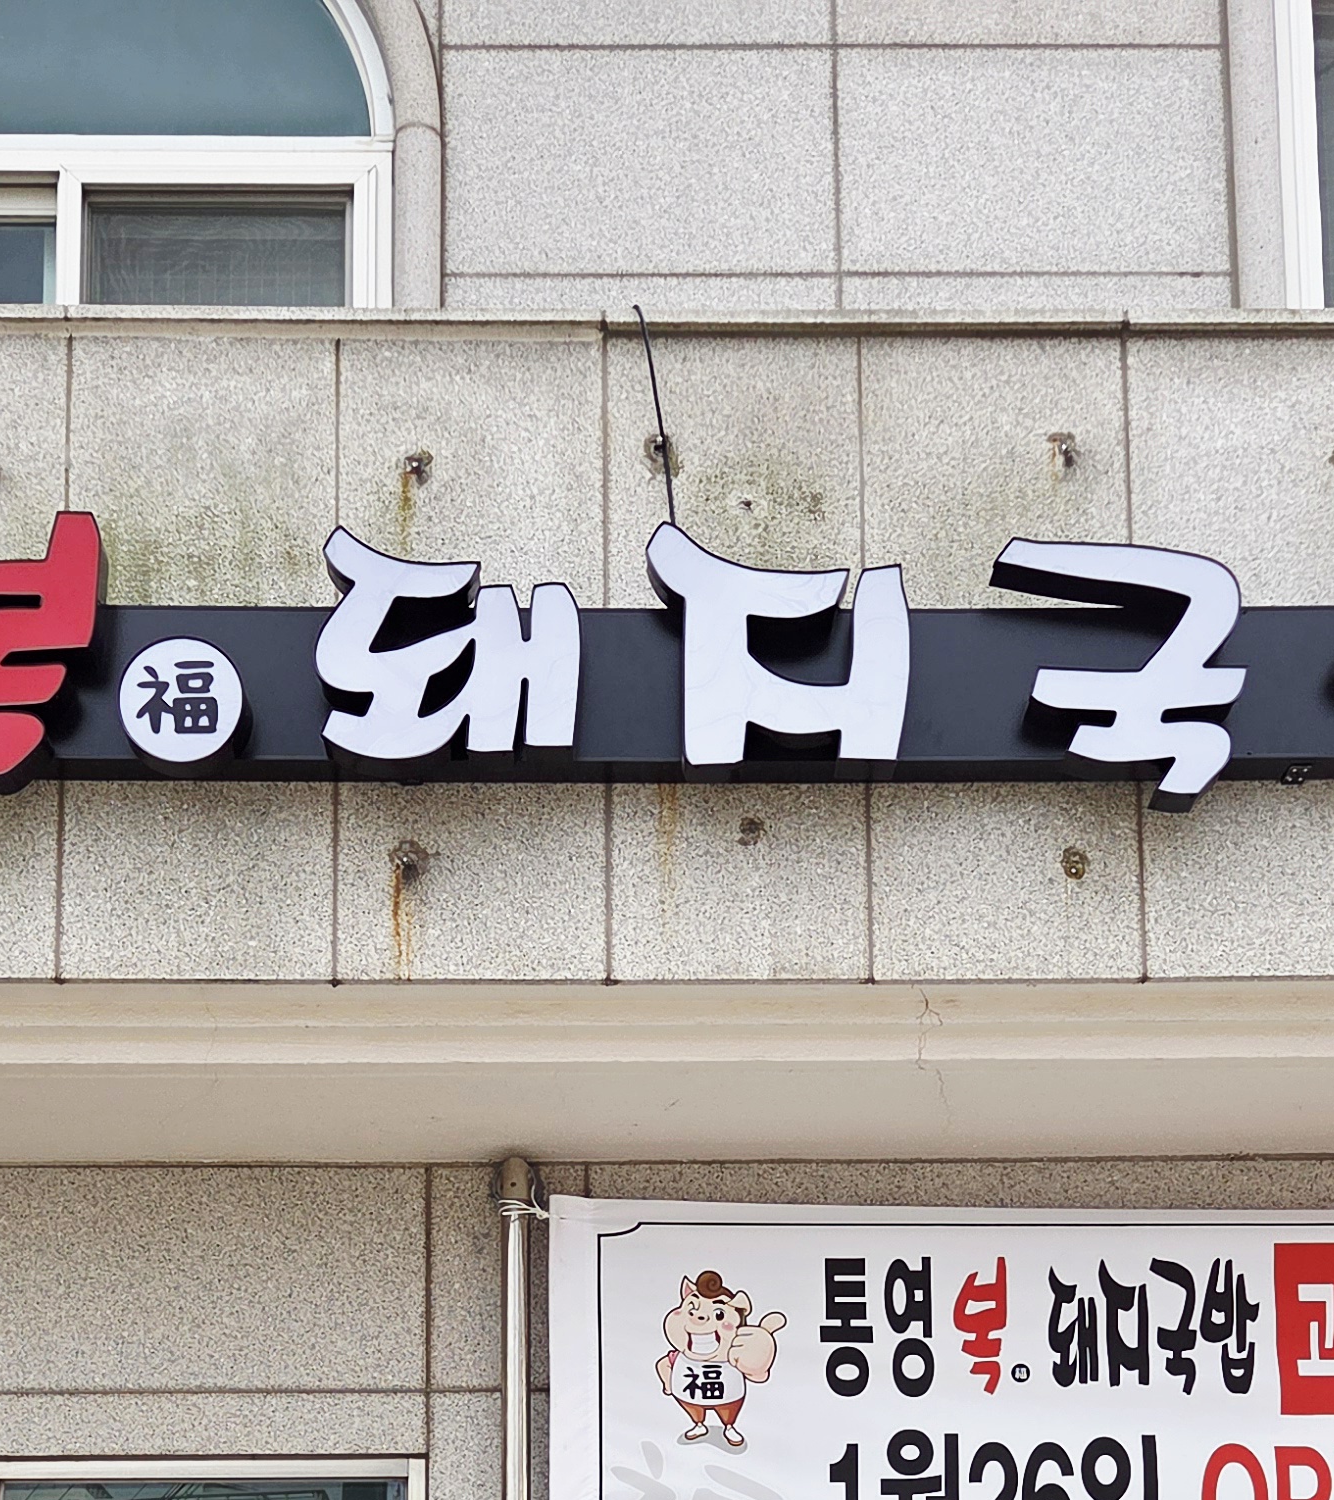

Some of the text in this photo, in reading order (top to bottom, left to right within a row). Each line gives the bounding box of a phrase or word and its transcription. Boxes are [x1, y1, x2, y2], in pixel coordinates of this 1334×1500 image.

[136, 664, 219, 735] 福
[819, 1256, 1007, 1398] 통영 복
[1048, 1257, 1260, 1396] 돼지국밥
[682, 1363, 725, 1400] 福
